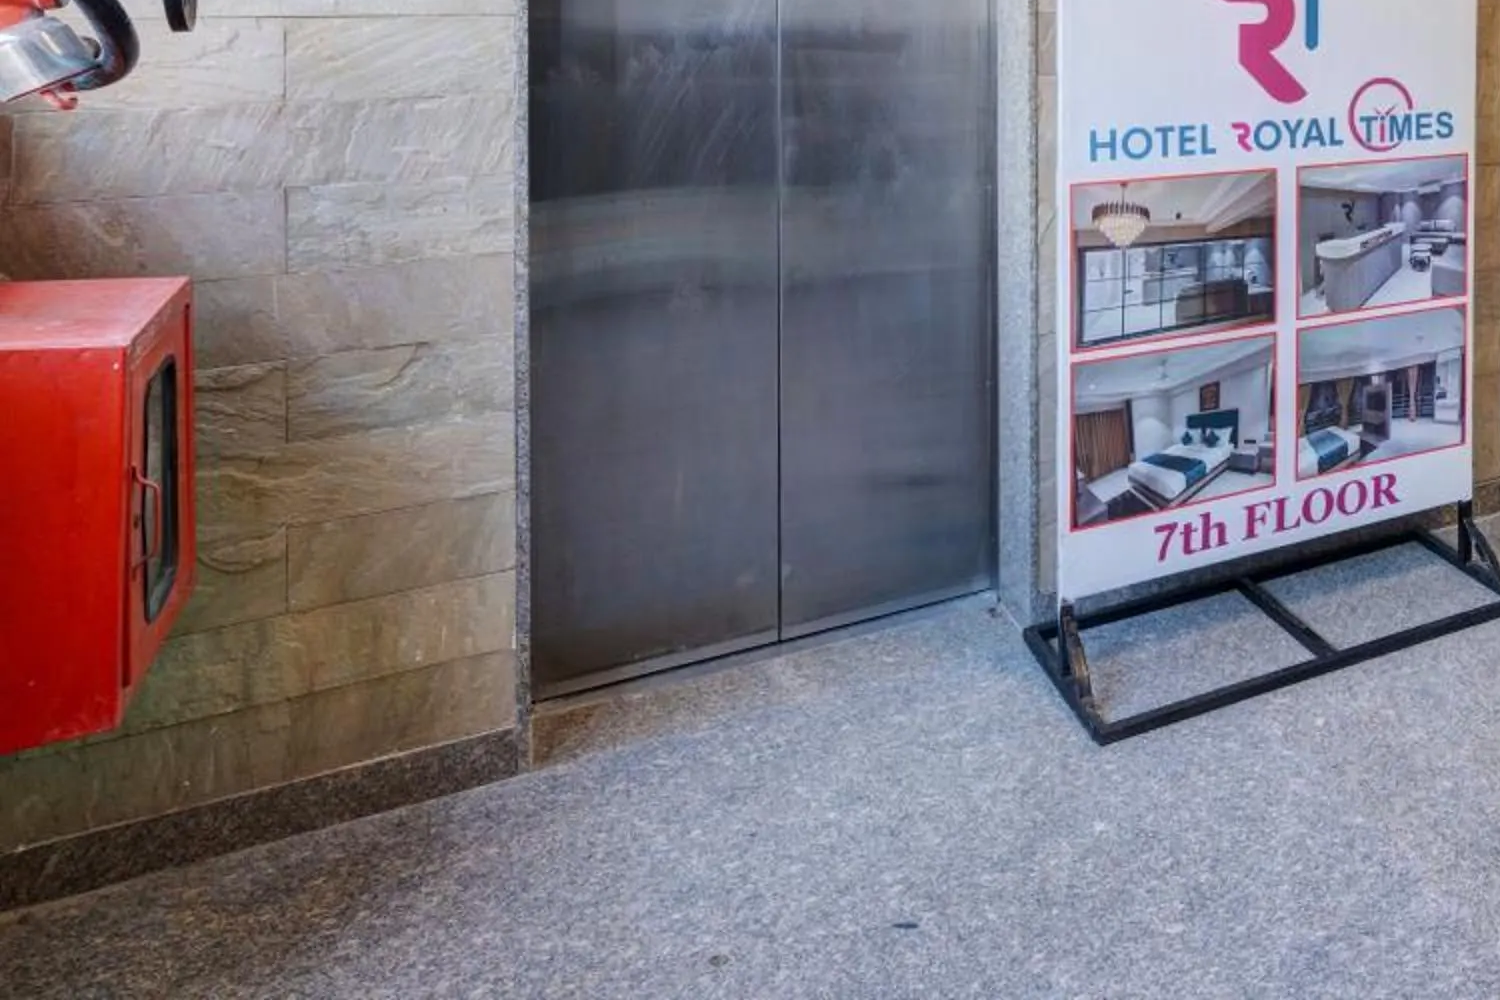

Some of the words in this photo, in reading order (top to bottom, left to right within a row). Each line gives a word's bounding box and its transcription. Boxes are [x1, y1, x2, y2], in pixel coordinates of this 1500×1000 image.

[1089, 125, 1217, 162] HOTEL
[1231, 117, 1344, 152] ROYAL
[1153, 512, 1229, 562] 7th
[1241, 472, 1400, 541] FLOOR
